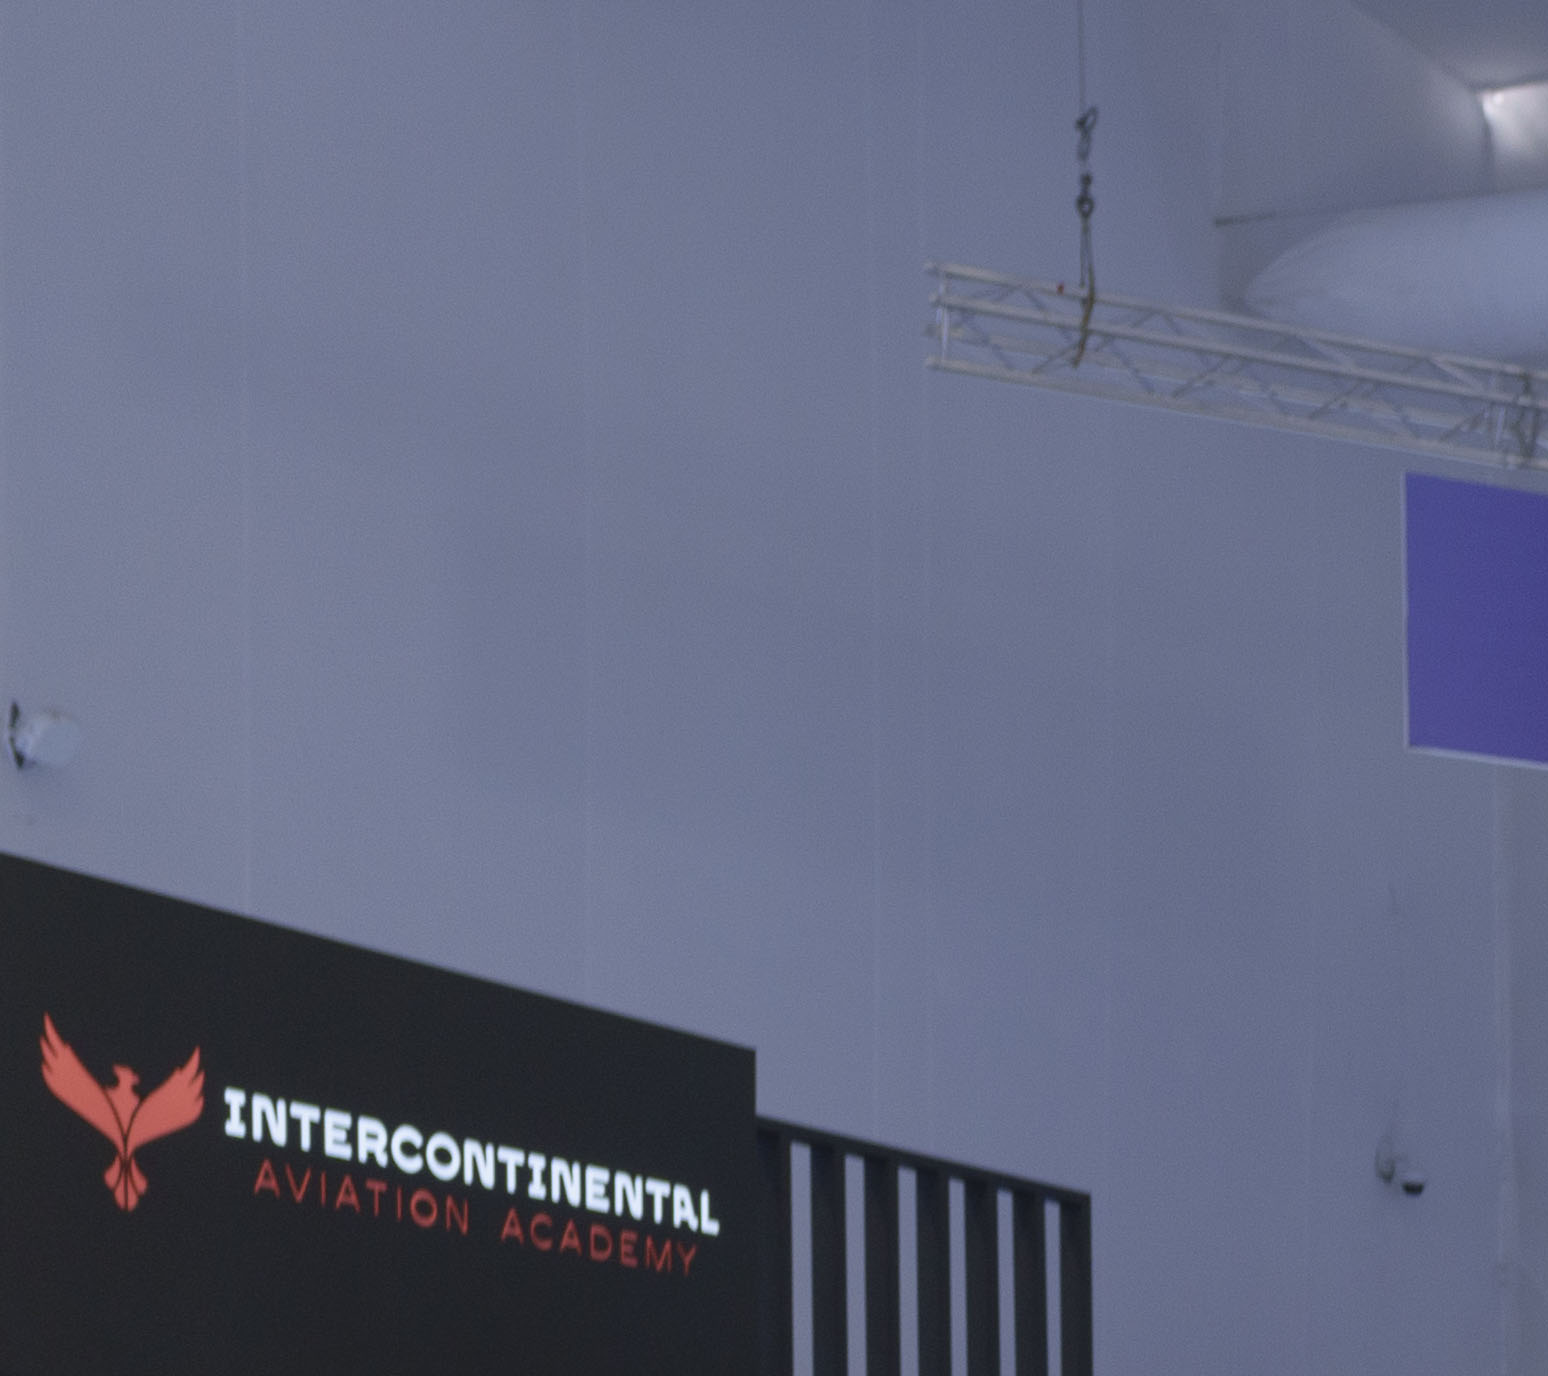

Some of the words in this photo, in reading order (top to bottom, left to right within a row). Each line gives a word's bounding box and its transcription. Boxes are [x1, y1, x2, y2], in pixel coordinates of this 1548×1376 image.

[223, 1086, 721, 1237] INTERCONTINENTAL
[253, 1157, 469, 1236] AVIATION
[500, 1208, 698, 1277] ACADEMY
